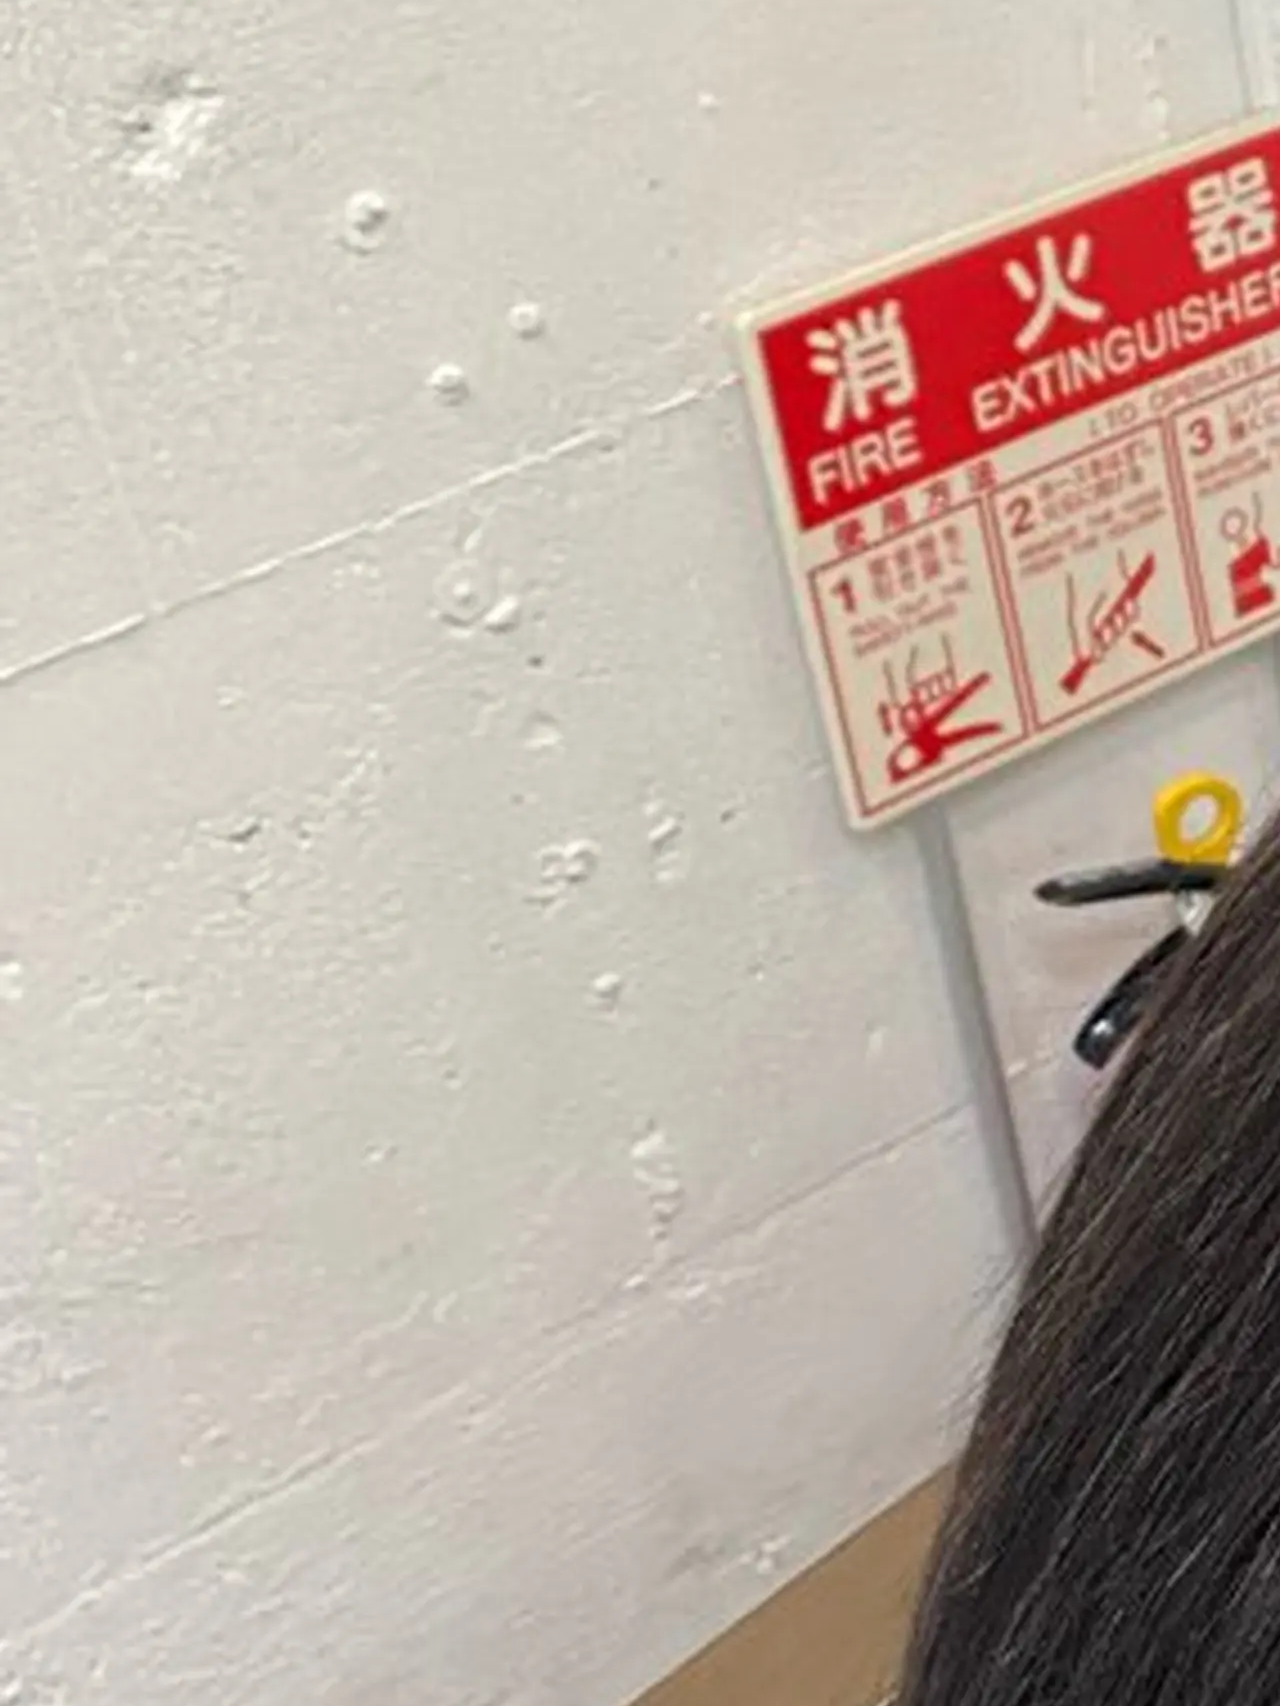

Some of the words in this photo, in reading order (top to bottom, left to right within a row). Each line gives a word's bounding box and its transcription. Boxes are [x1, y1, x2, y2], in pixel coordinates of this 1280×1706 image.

[807, 157, 1279, 433] 消火器
[1187, 414, 1214, 458] 3
[807, 416, 924, 507] FIRE
[1006, 495, 1036, 539] 2
[831, 579, 858, 615] 1
